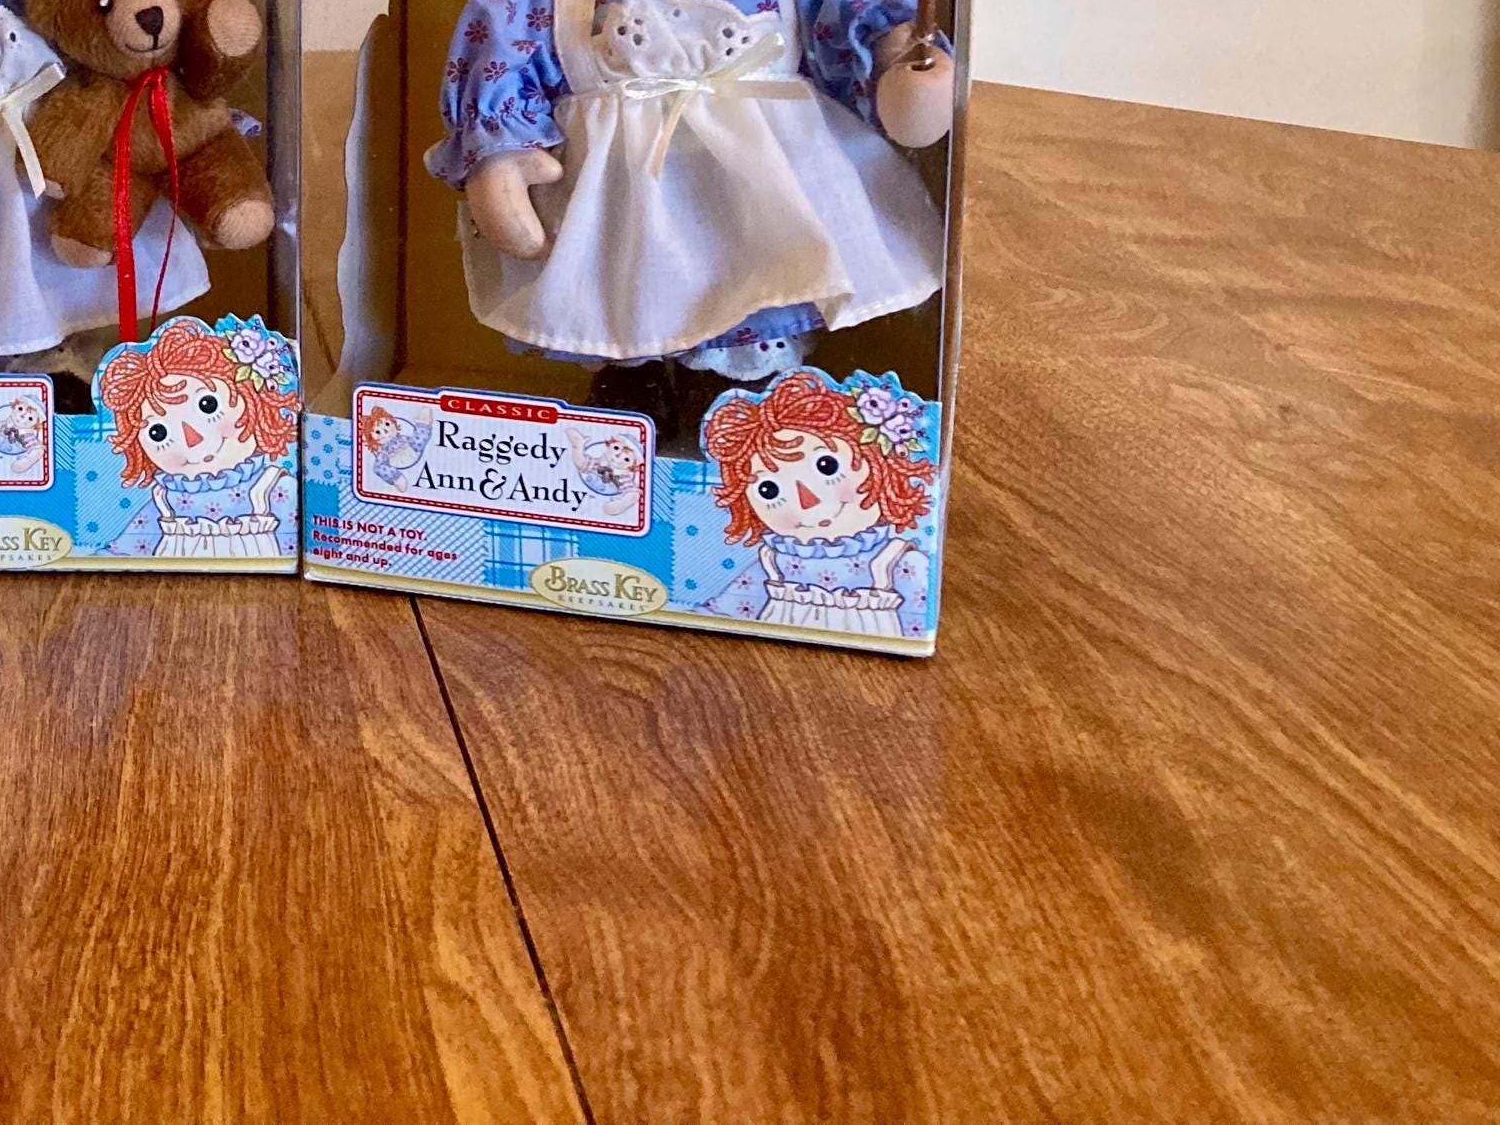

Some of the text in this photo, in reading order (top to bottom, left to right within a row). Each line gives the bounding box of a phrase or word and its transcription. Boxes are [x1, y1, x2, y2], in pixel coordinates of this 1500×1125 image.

[447, 399, 551, 420] CLASSIC
[436, 420, 567, 469] Raggedy
[312, 514, 339, 528] THIS
[342, 519, 353, 531] IS
[357, 522, 384, 535] NOT
[387, 527, 396, 537] A
[23, 527, 62, 552] KEY
[313, 530, 458, 561] Recommended for ages
[312, 547, 343, 560] eight
[346, 552, 369, 563] and
[544, 565, 659, 603] BRASS KEY
